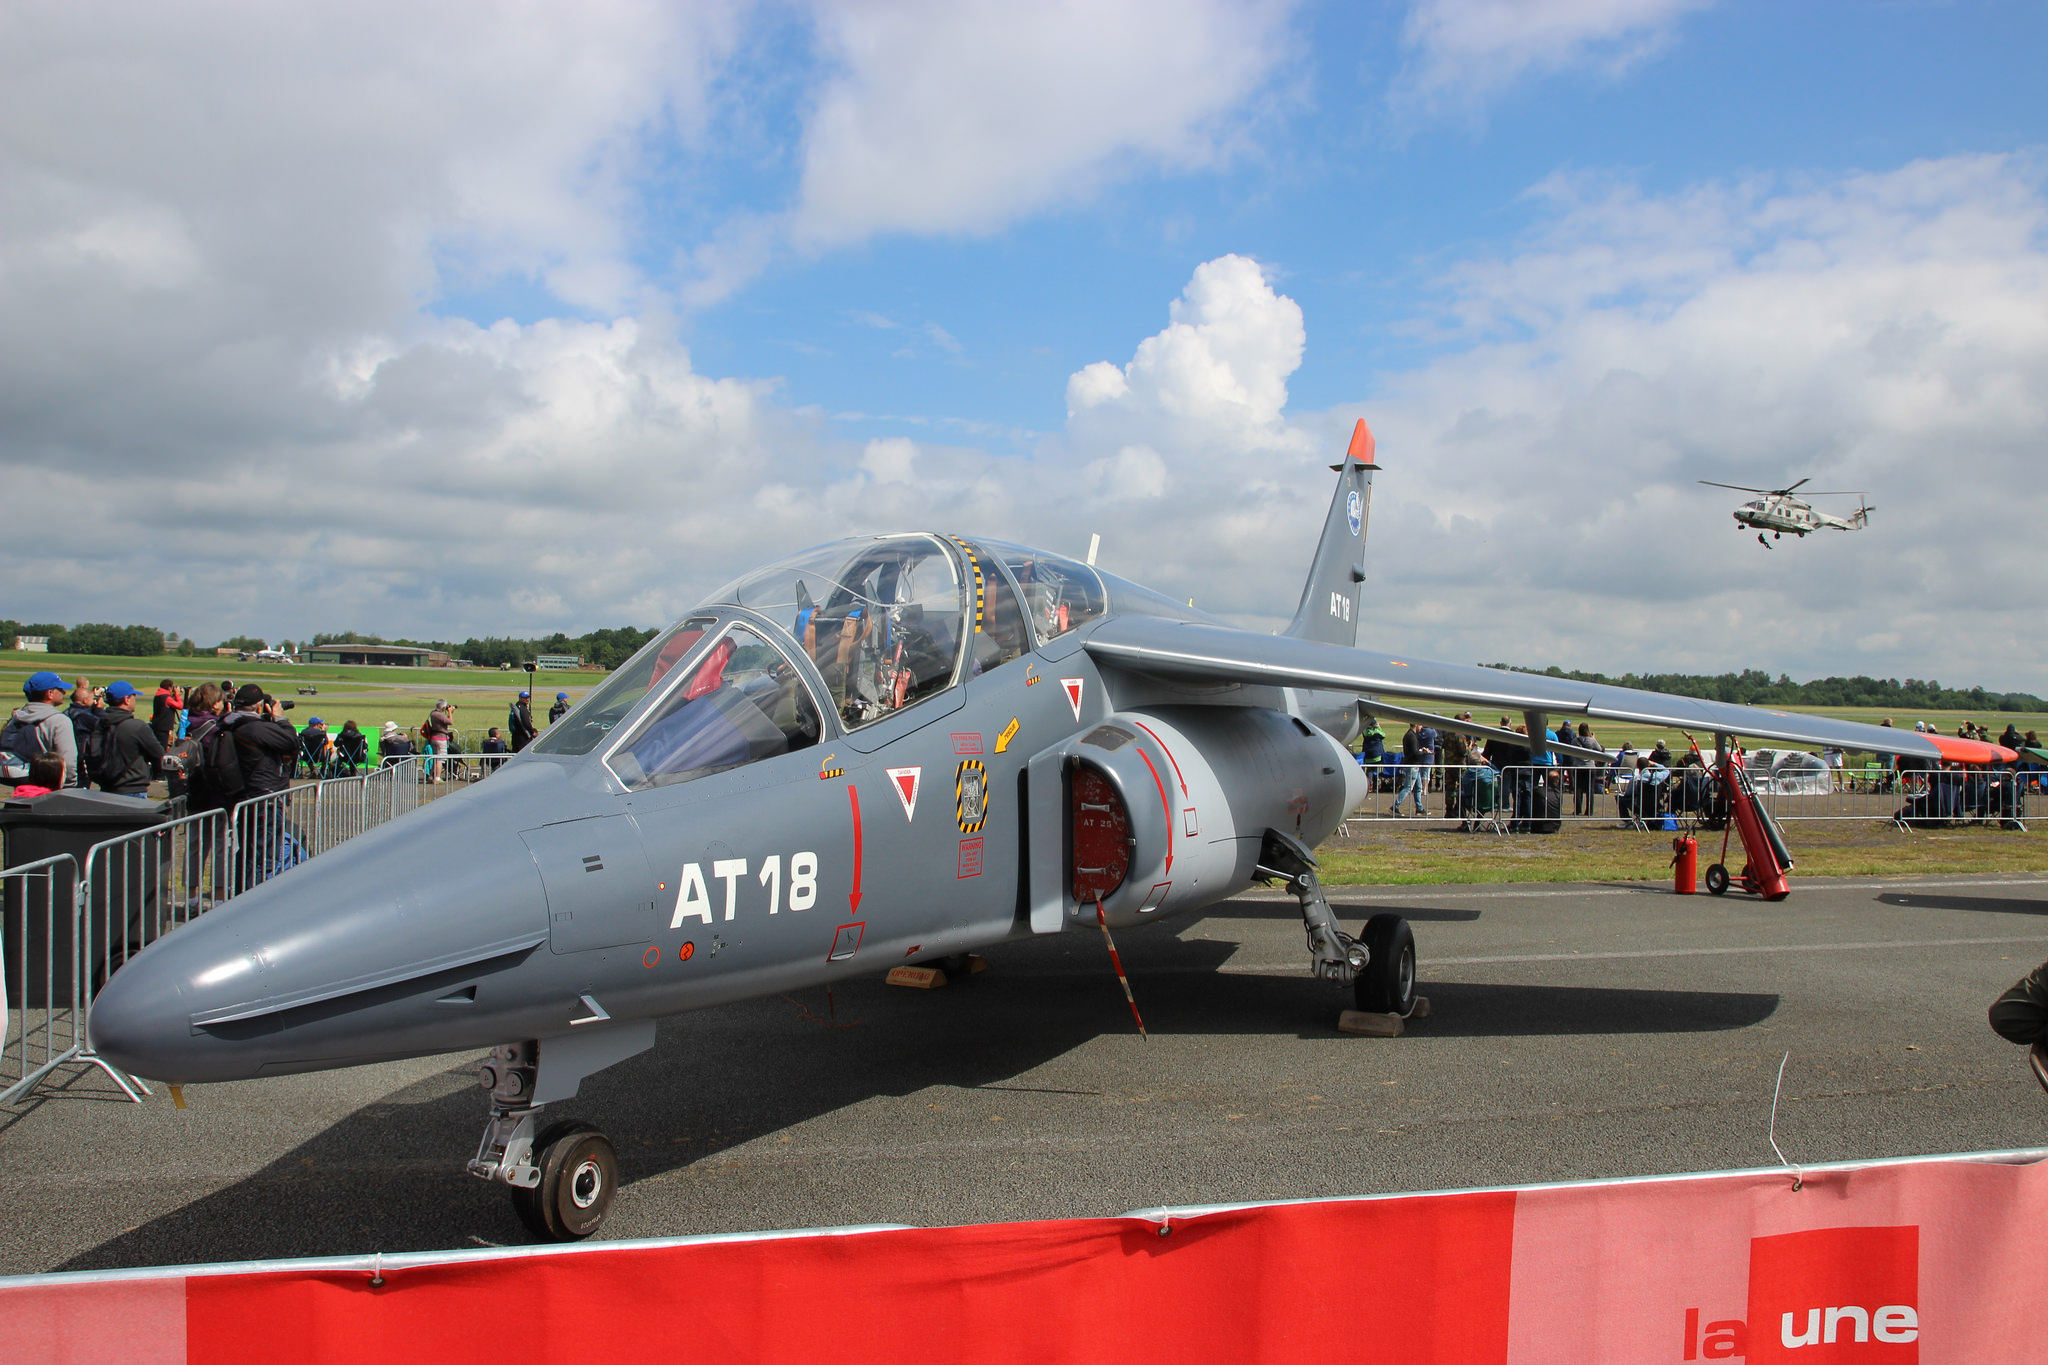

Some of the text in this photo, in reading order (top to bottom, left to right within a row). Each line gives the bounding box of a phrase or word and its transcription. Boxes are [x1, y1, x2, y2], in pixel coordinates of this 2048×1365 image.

[1083, 818, 1095, 827] AT
[1684, 1304, 1919, 1361] la une
